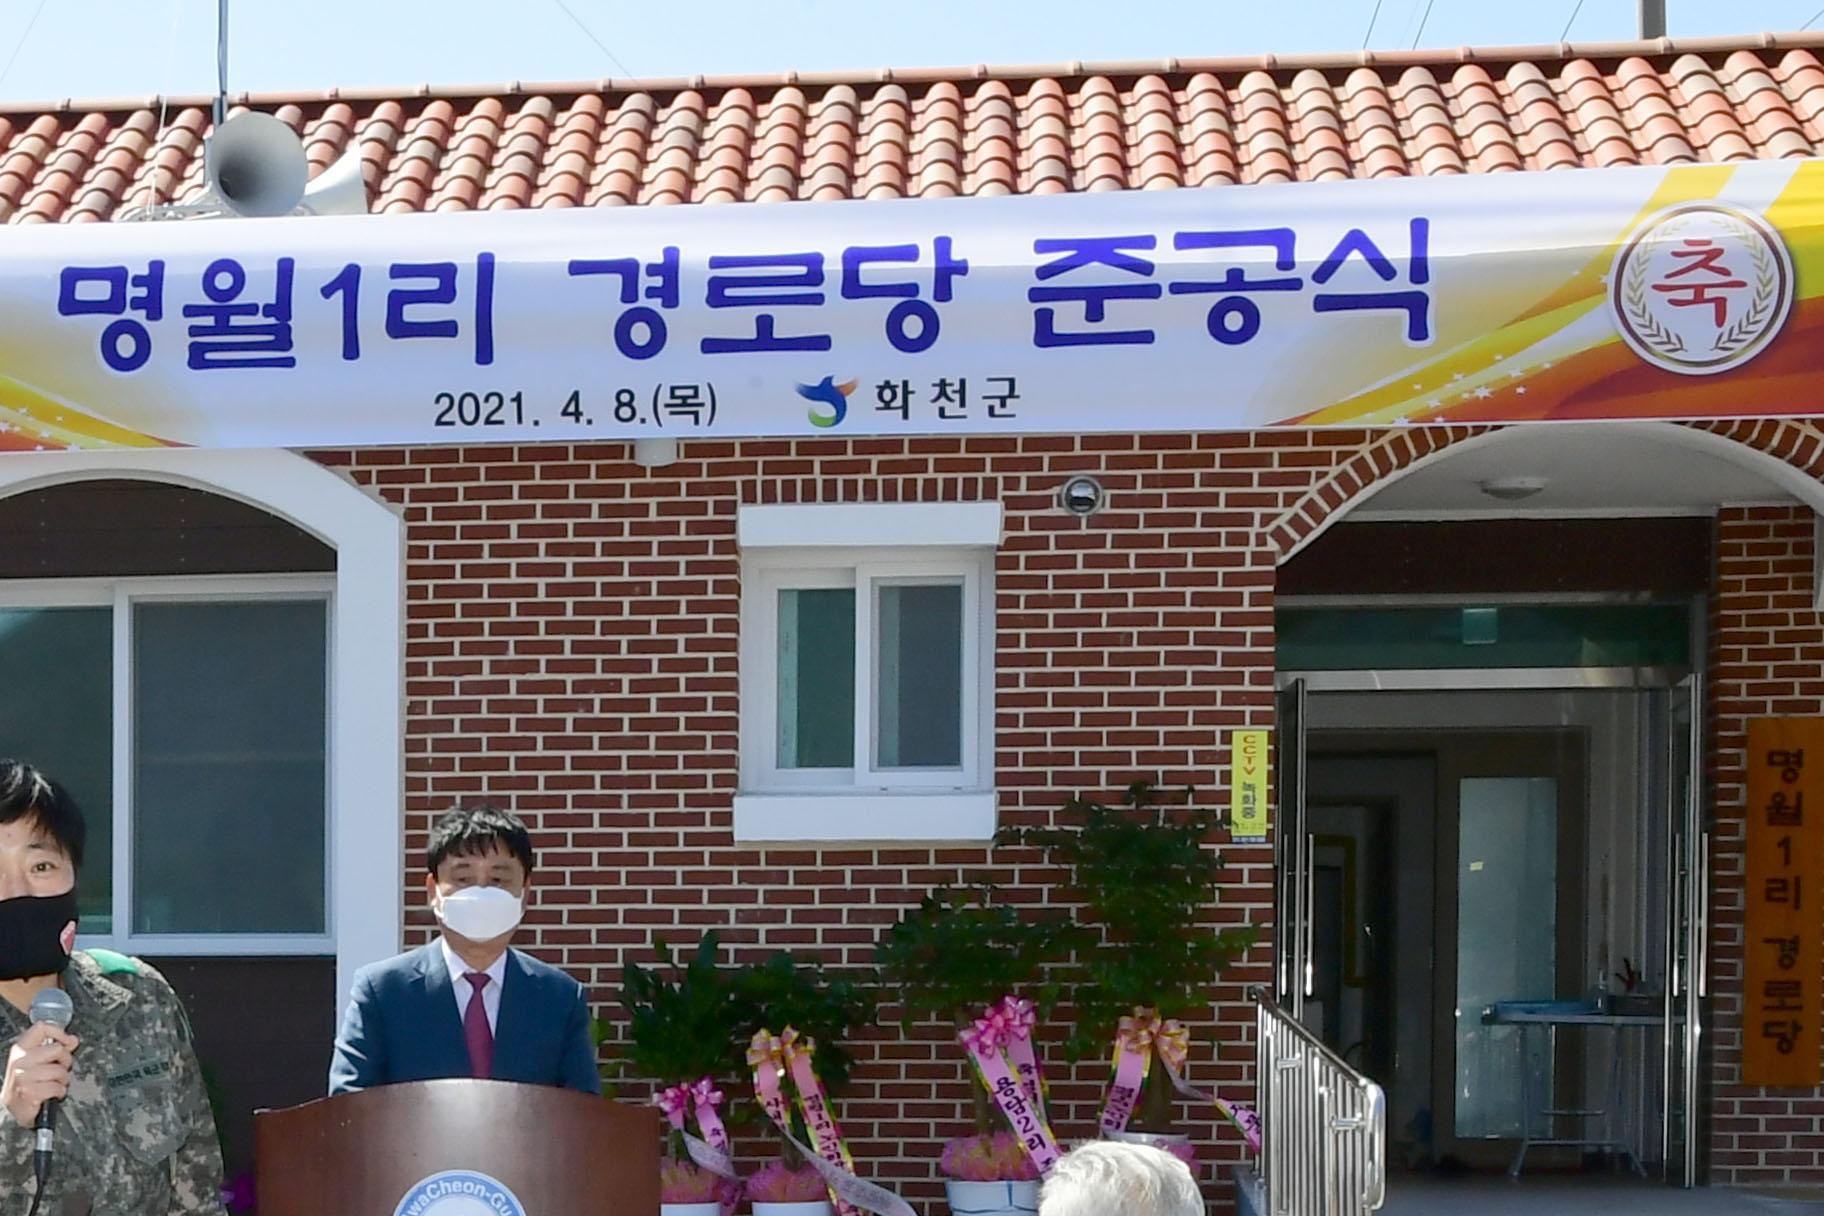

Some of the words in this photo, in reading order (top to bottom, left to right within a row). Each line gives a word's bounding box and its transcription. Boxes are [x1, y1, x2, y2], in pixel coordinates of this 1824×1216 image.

[58, 253, 494, 372] 명월1리
[568, 237, 968, 360] 경로당
[1028, 218, 1429, 348] 준공식
[1651, 239, 1749, 328] 축
[435, 392, 539, 426] 2021.
[561, 391, 592, 425] 4.
[875, 377, 1020, 421] 화천군
[1242, 735, 1256, 775] CCTV
[1764, 748, 1803, 910] 명월1리
[1761, 932, 1804, 1055] 경로당
[996, 1077, 1046, 1150] 용담2리
